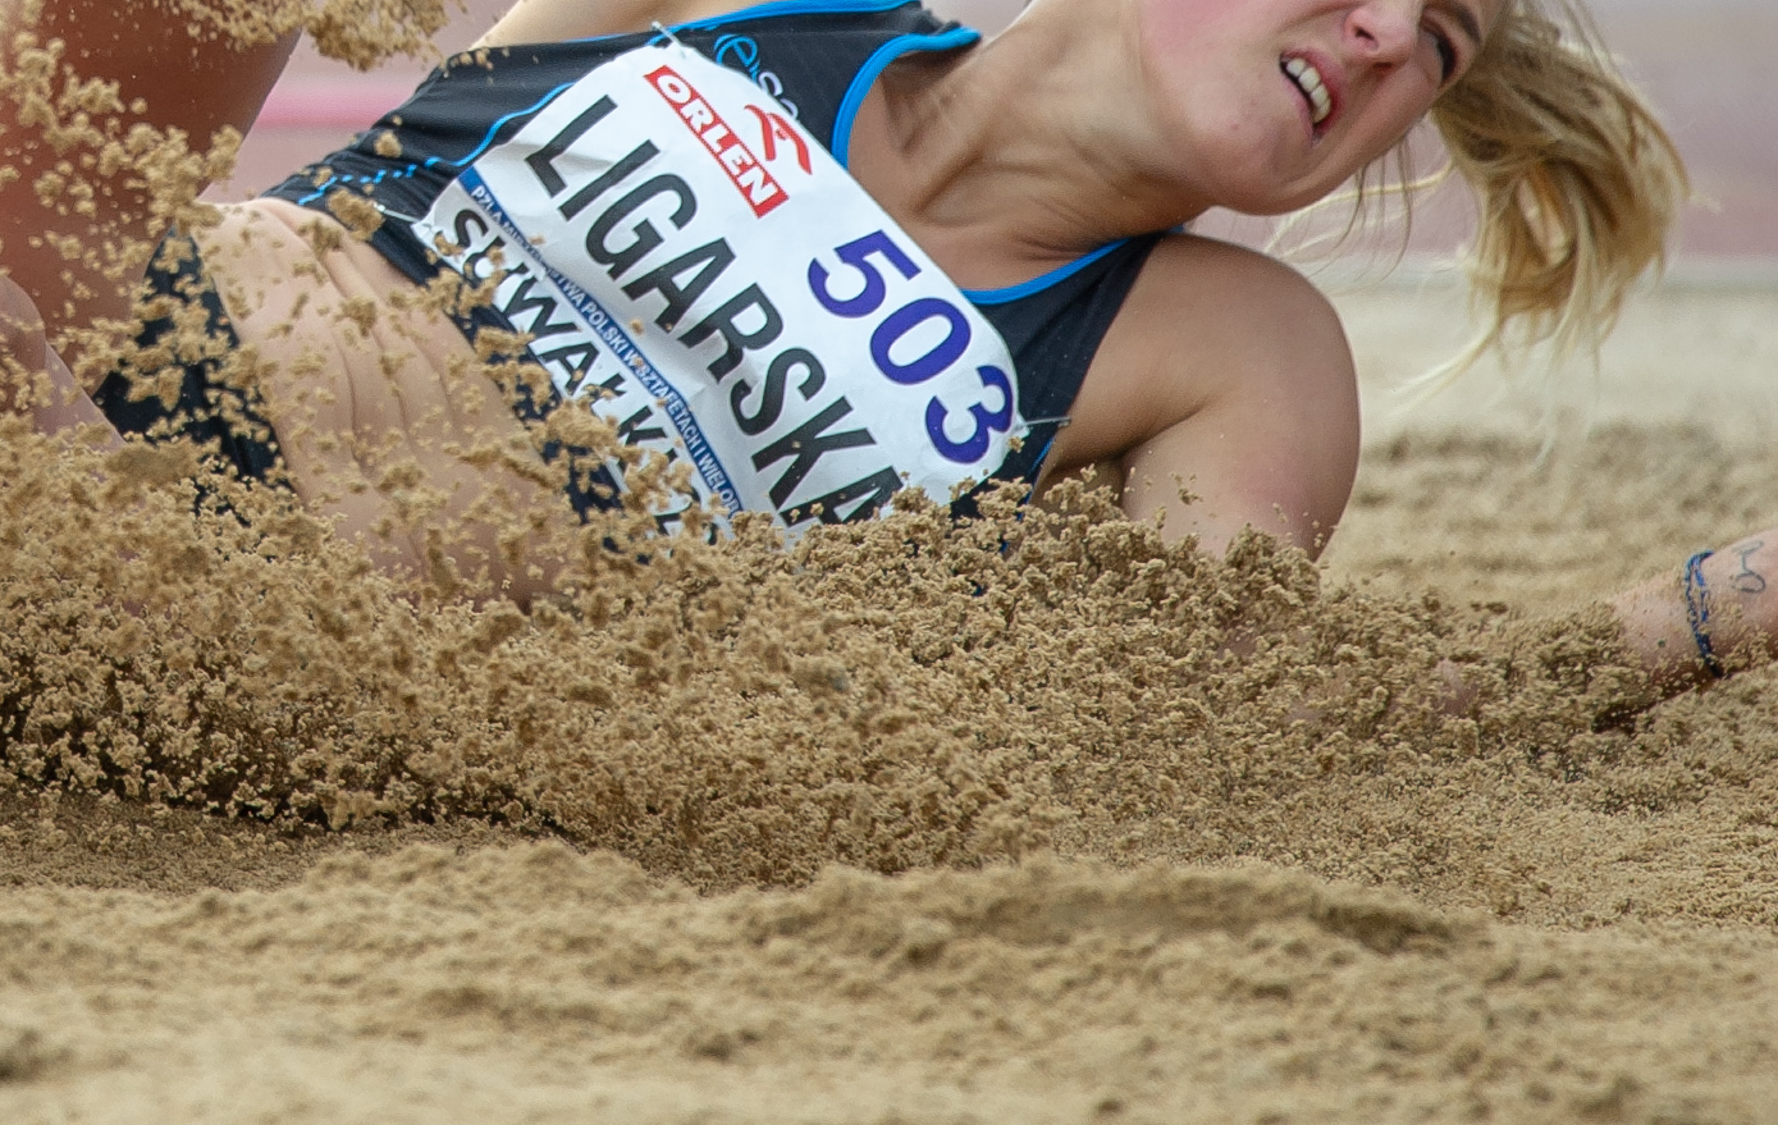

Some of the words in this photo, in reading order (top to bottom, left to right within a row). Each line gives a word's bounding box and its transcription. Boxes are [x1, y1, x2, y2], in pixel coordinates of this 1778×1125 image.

[656, 74, 779, 207] ORLEN
[524, 94, 904, 529] LIGARSKA
[580, 302, 629, 357] POLSKI
[807, 228, 1014, 465] 503
[635, 360, 702, 452] SZTAFETACH
[693, 446, 706, 460] I
[698, 454, 741, 520] WIELOB
